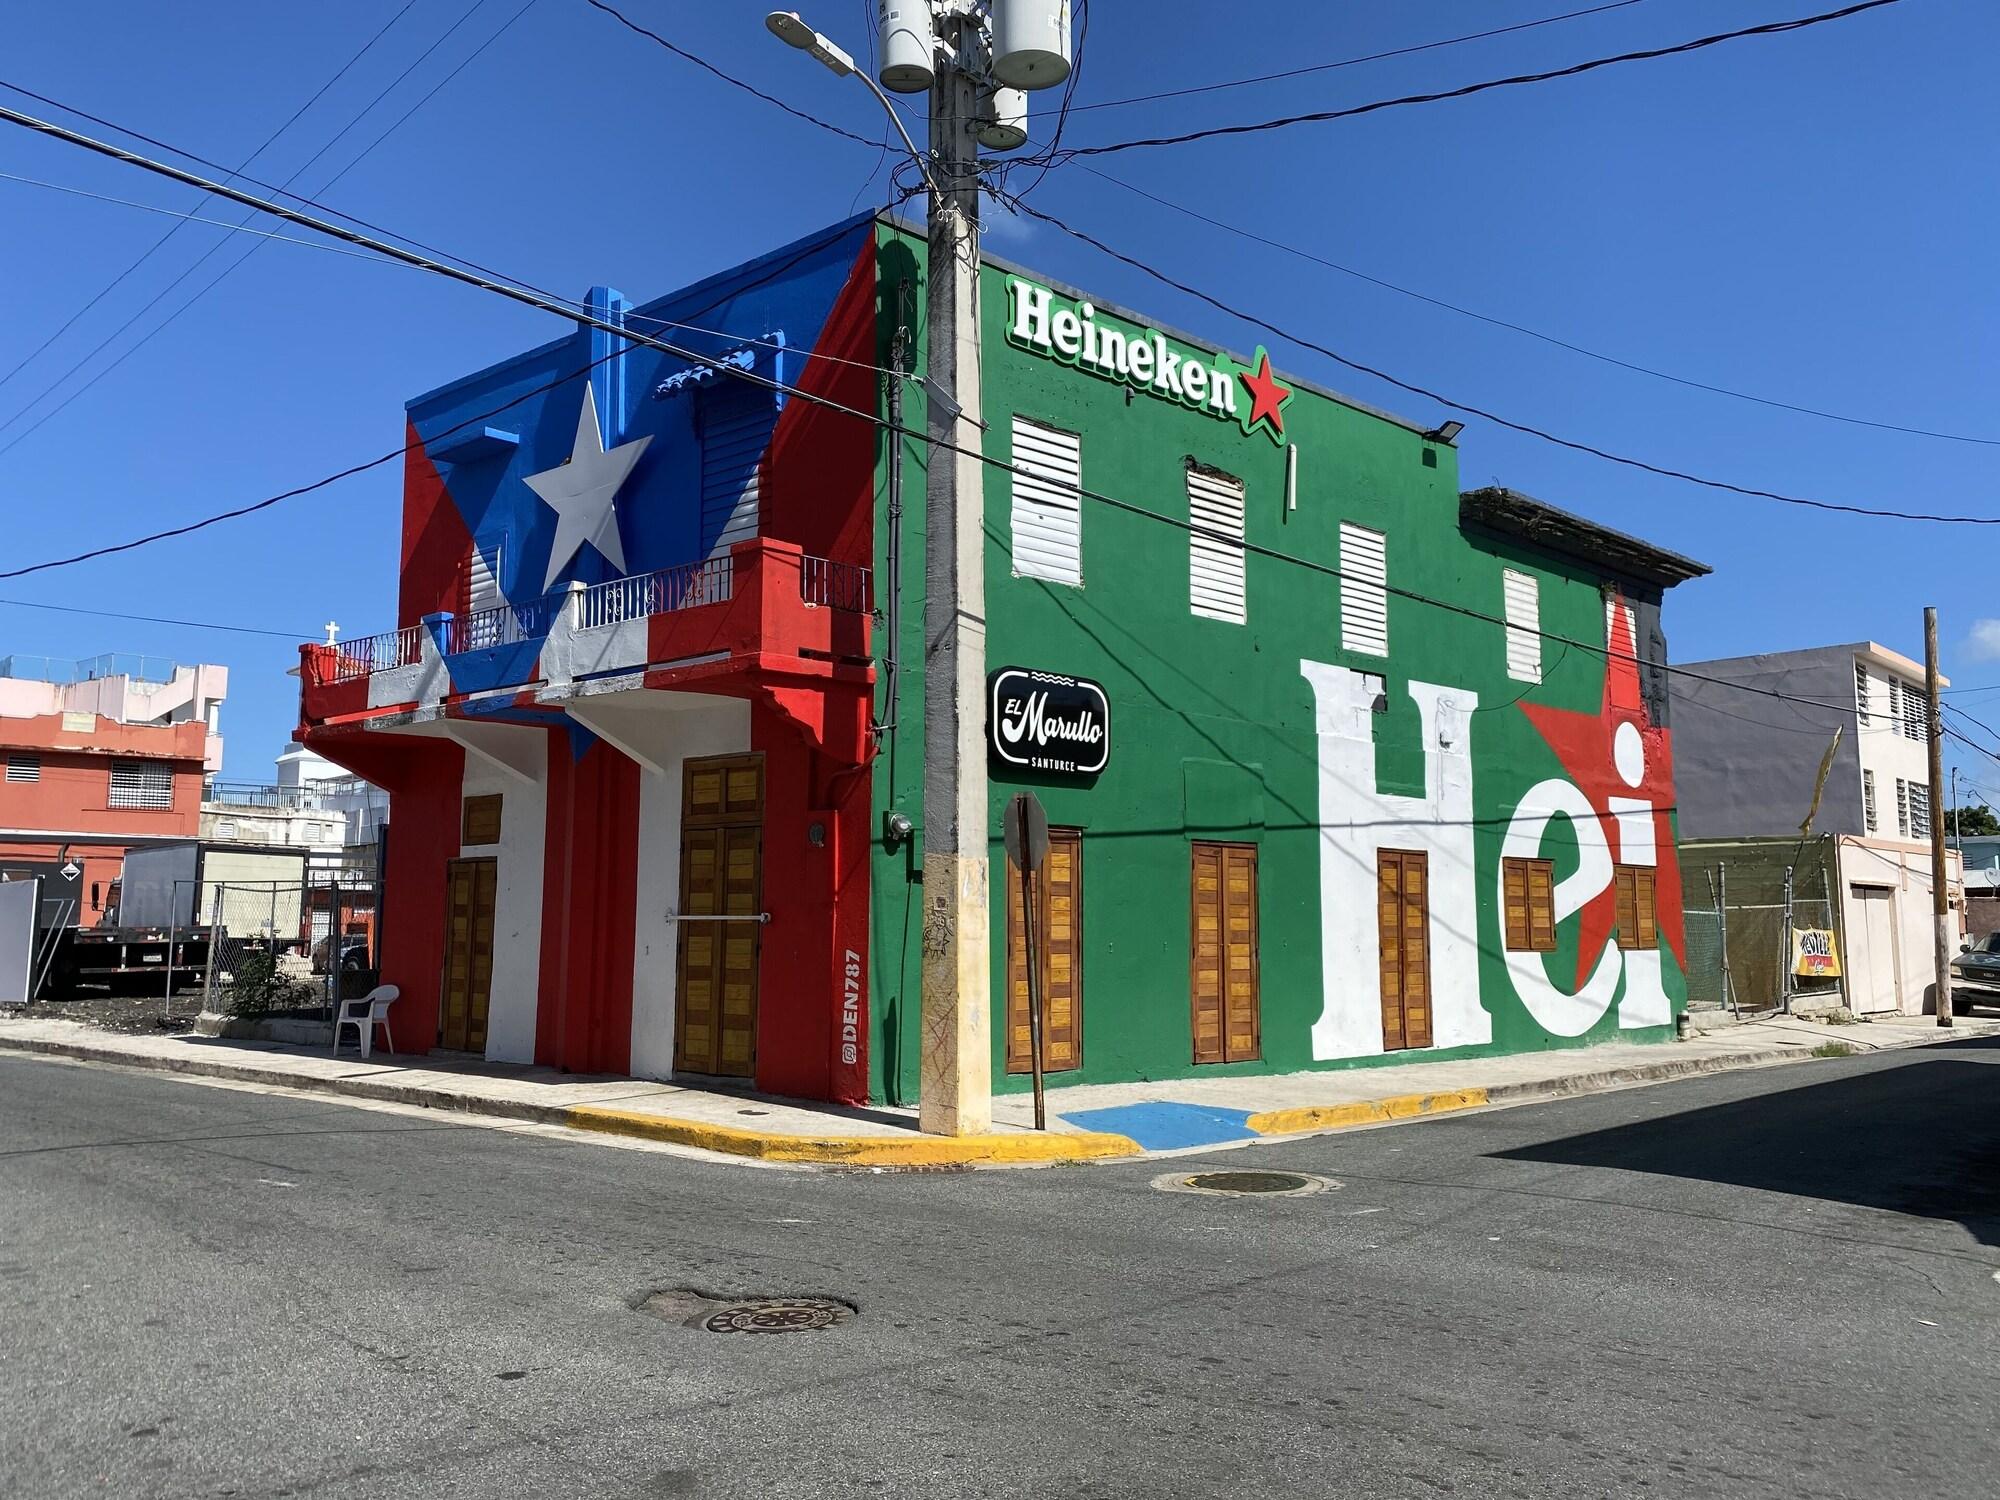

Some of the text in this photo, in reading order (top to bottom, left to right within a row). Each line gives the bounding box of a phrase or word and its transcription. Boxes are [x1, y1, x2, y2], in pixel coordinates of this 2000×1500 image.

[1012, 279, 1238, 413] Heineken
[1001, 690, 1103, 746] EL Marullo
[1031, 756, 1075, 772] SANTURCE
[1300, 658, 1672, 1061] Hei
